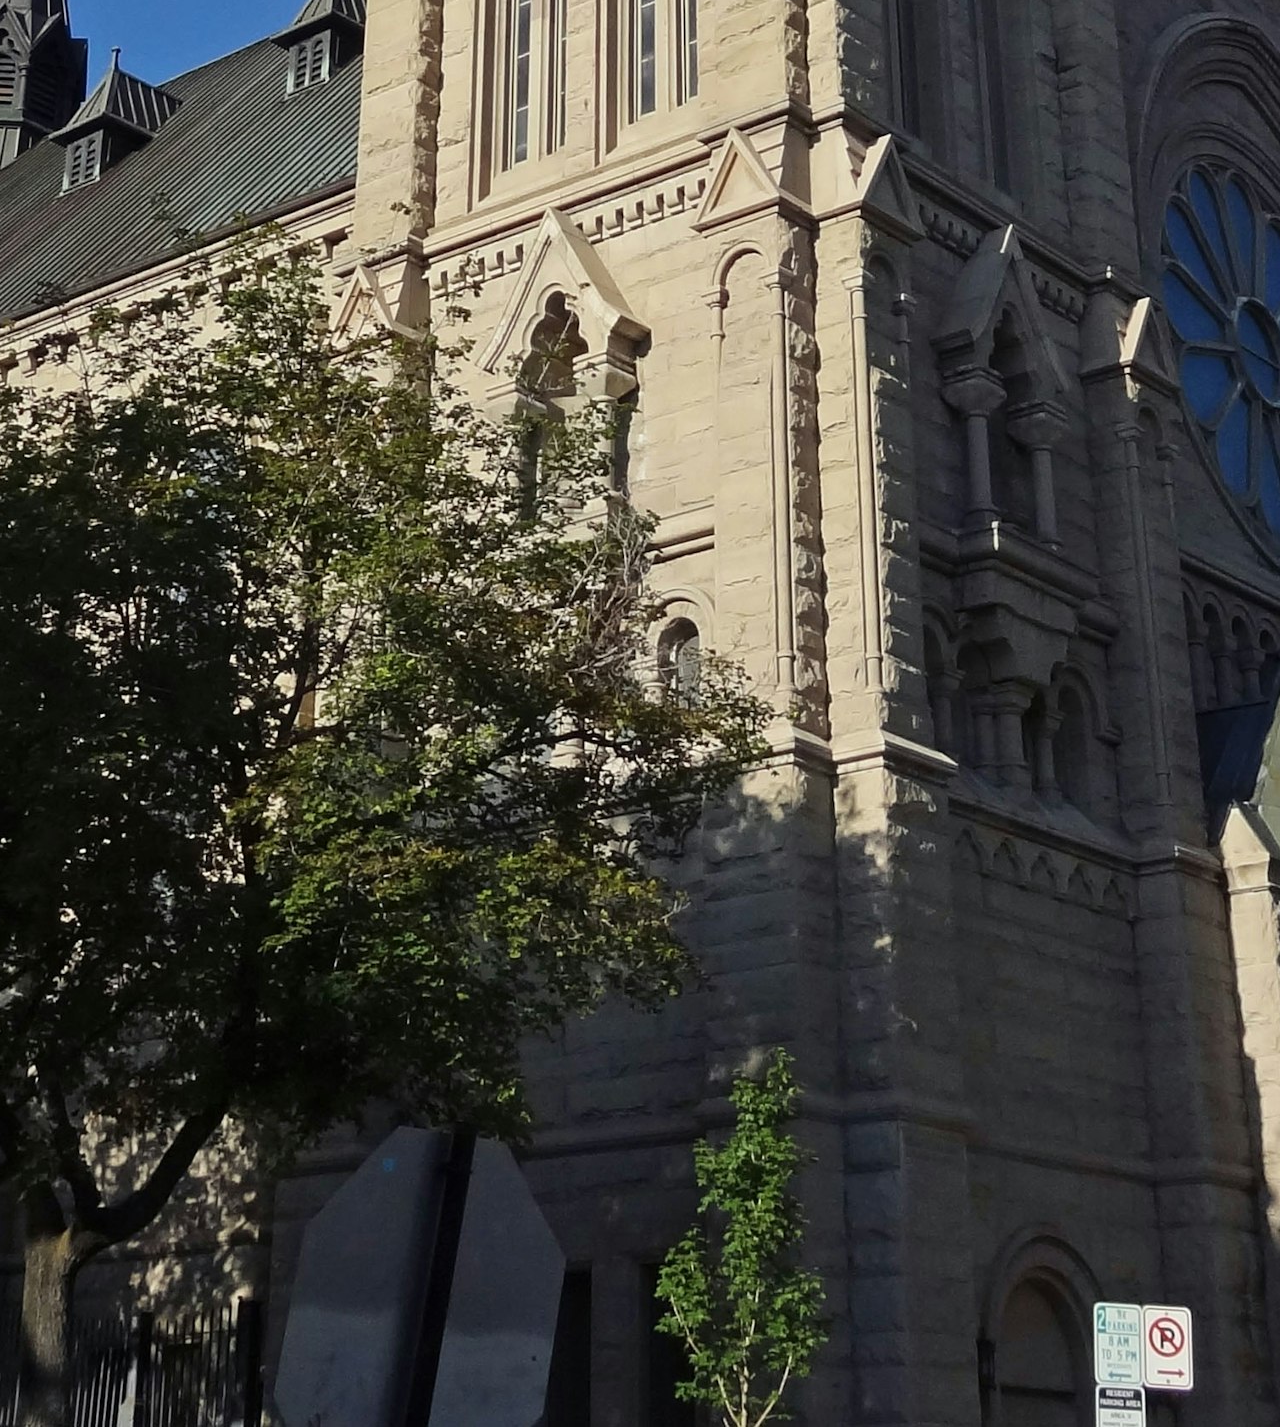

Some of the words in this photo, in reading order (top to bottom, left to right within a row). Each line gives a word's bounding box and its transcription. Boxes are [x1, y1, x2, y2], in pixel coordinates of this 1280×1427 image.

[1098, 1309, 1106, 1330] 2
[1108, 1321, 1138, 1333] PARKING
[1117, 1337, 1129, 1347] AM
[1102, 1348, 1111, 1360] TO
[1125, 1350, 1137, 1362] PM
[1125, 1399, 1141, 1408] AREA
